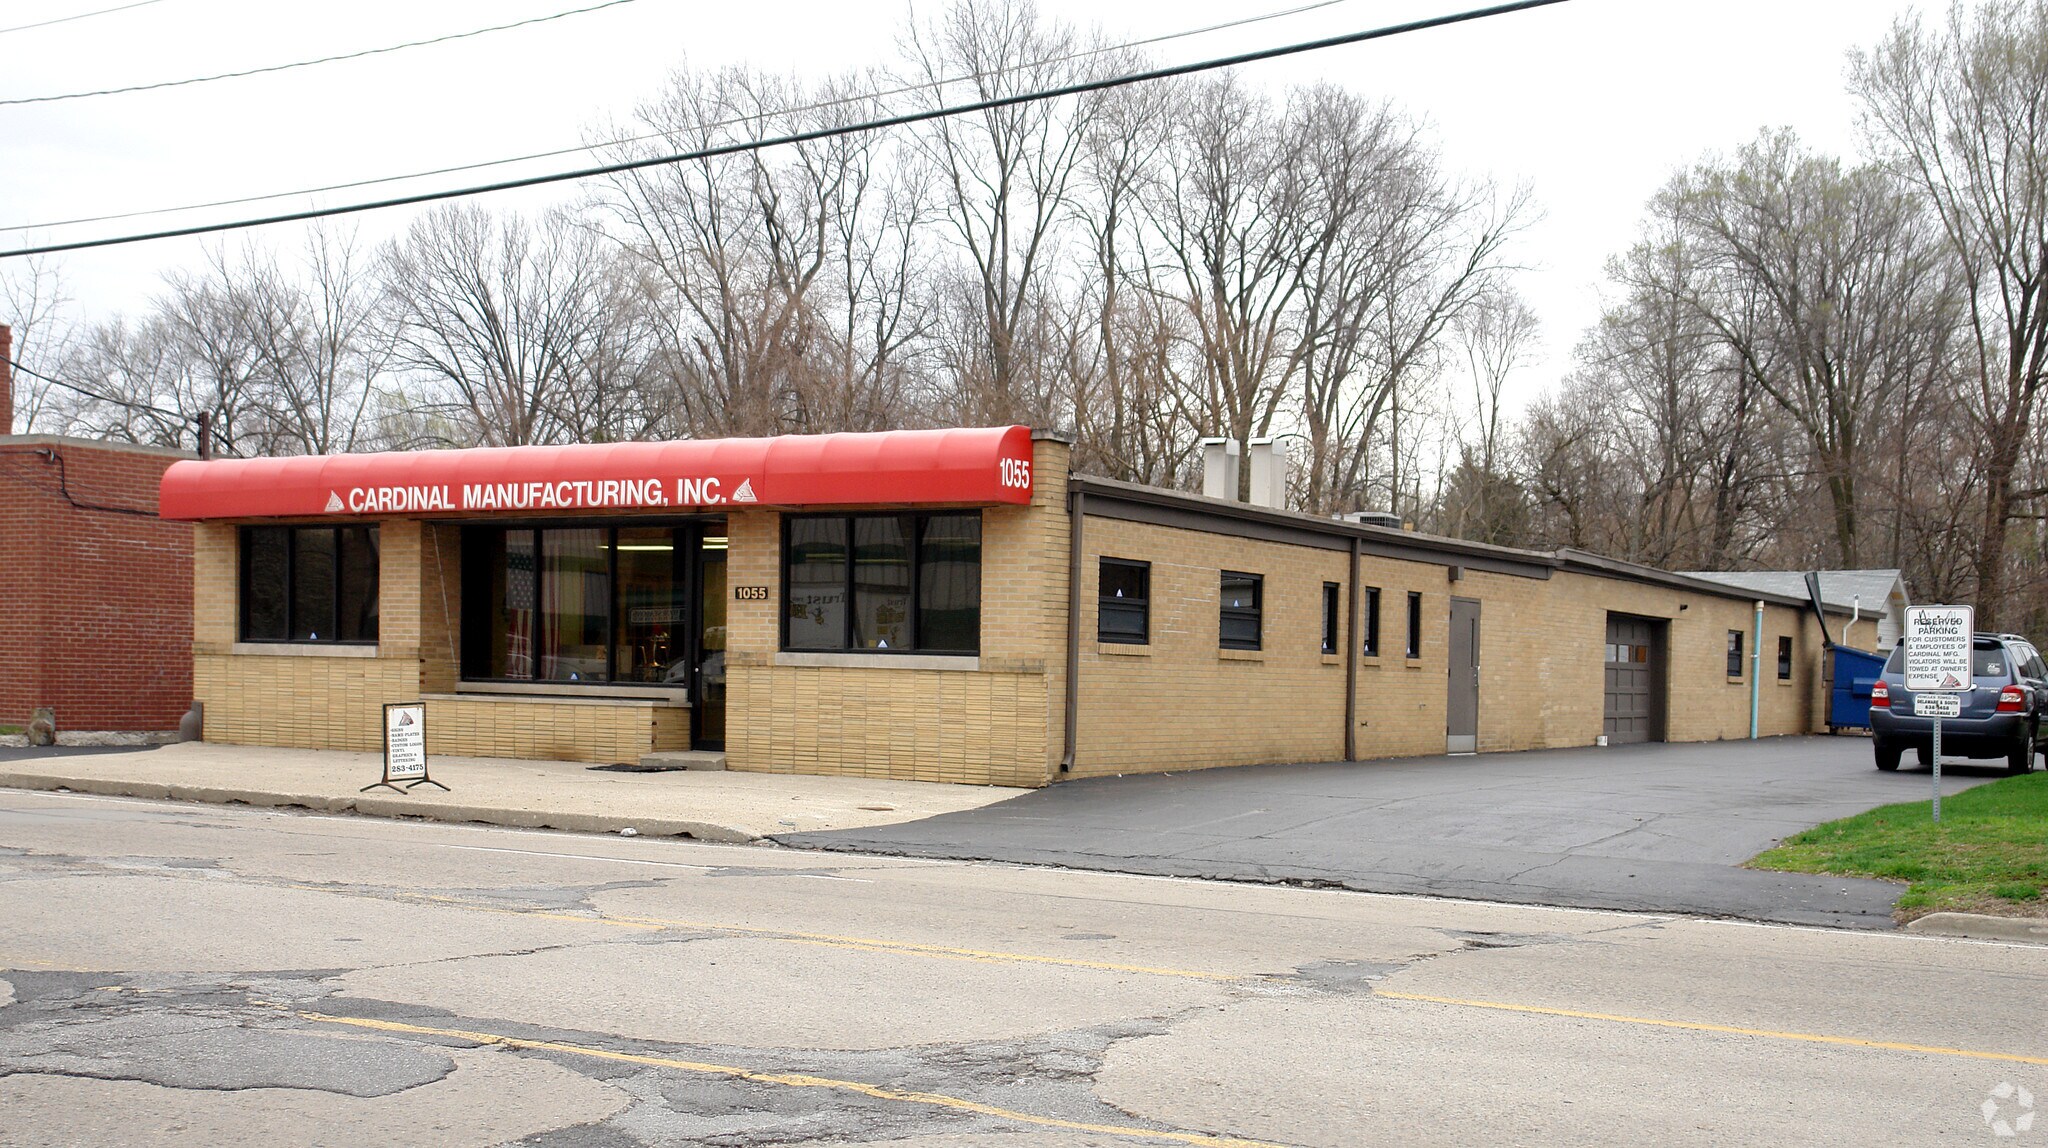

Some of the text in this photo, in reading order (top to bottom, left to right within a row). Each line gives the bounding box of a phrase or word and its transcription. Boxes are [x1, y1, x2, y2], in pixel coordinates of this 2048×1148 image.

[1000, 457, 1030, 489] 1055
[349, 476, 727, 514] CARDINAL MANUFACTURING, INC.
[737, 586, 767, 600] 1055
[1913, 618, 1963, 626] RESERVED
[1918, 627, 1958, 635] PARKING
